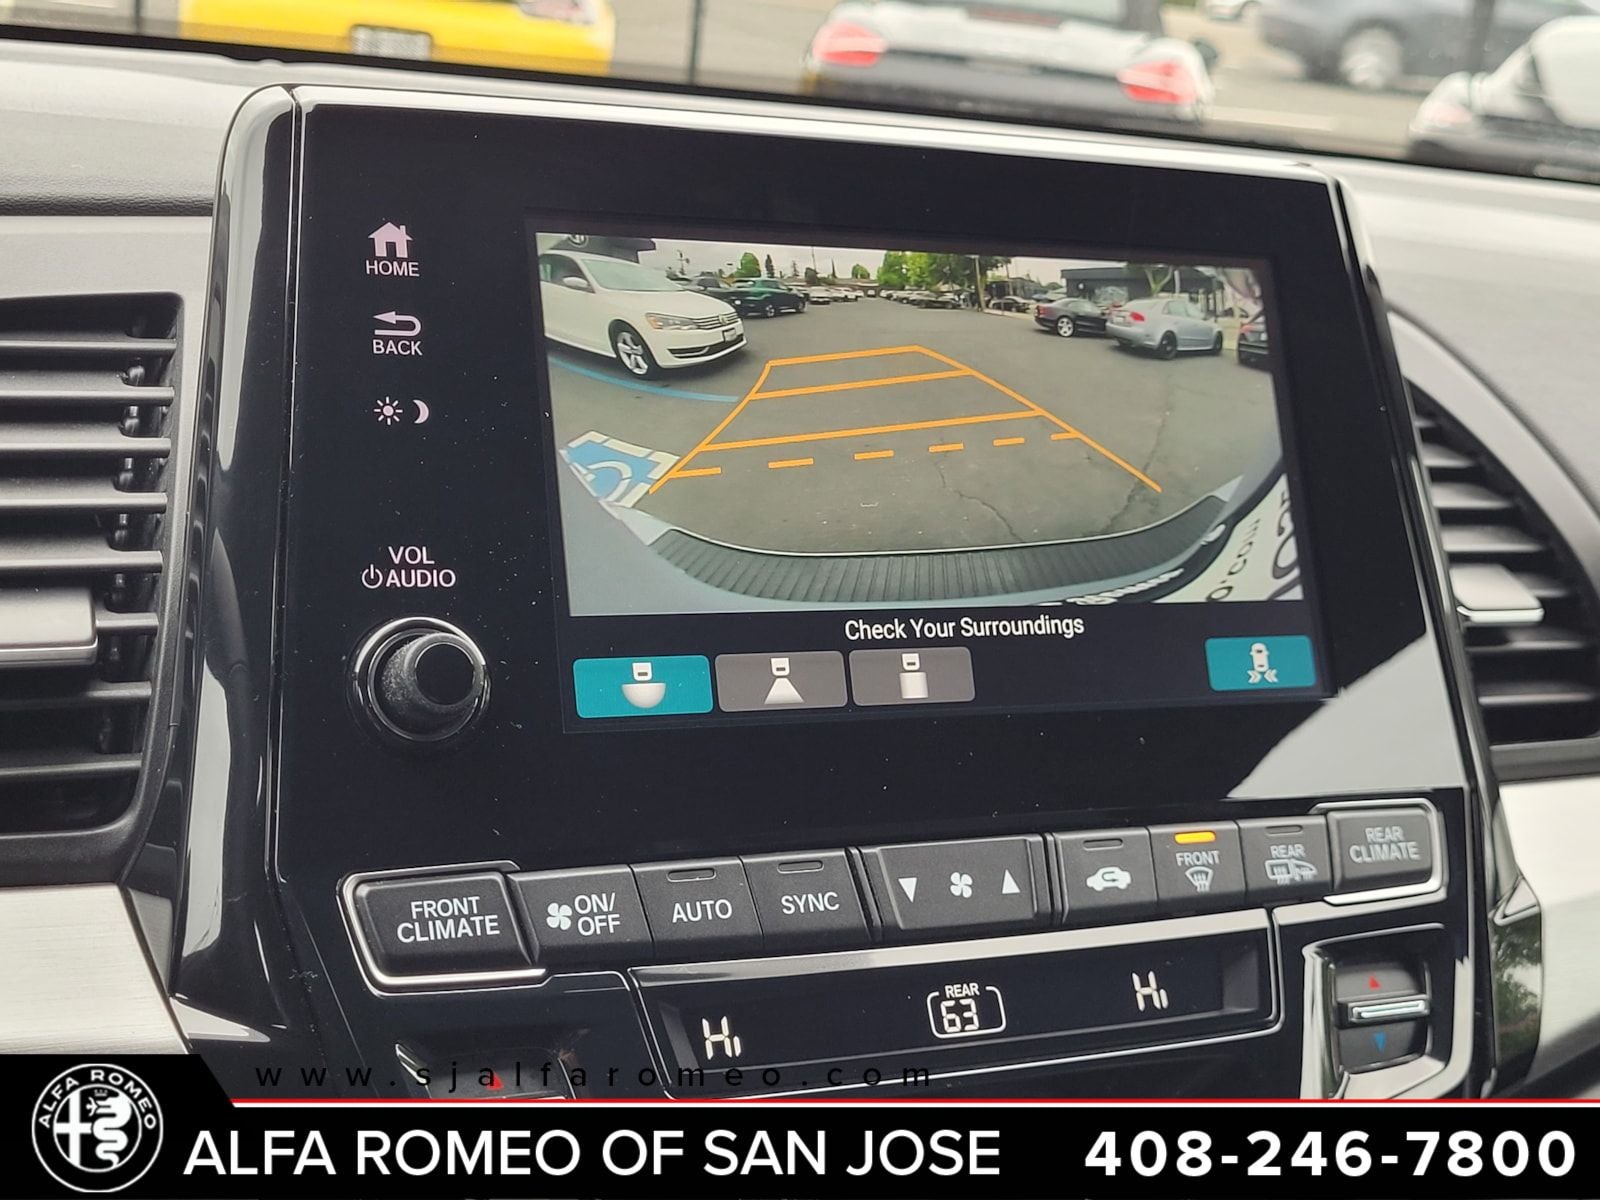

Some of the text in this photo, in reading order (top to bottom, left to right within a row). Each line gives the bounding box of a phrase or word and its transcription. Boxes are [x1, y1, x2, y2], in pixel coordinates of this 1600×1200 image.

[366, 260, 420, 277] HOME
[373, 340, 422, 355] BACK
[388, 546, 434, 564] VOL
[386, 569, 456, 587] AUDIO
[845, 615, 1084, 640] Check Your Surroundings
[1365, 826, 1404, 843] REAR
[1175, 849, 1221, 866] FRONT
[1270, 844, 1306, 859] REAR
[1349, 841, 1421, 864] CLIMATE
[410, 896, 481, 920] FRONT
[574, 892, 616, 915] ON/
[671, 899, 733, 924] AUTO
[781, 891, 840, 916] SYNC
[396, 914, 501, 944] CLIMATE
[577, 914, 622, 937] OFF
[945, 983, 980, 998] REAR
[940, 998, 980, 1033] 63
